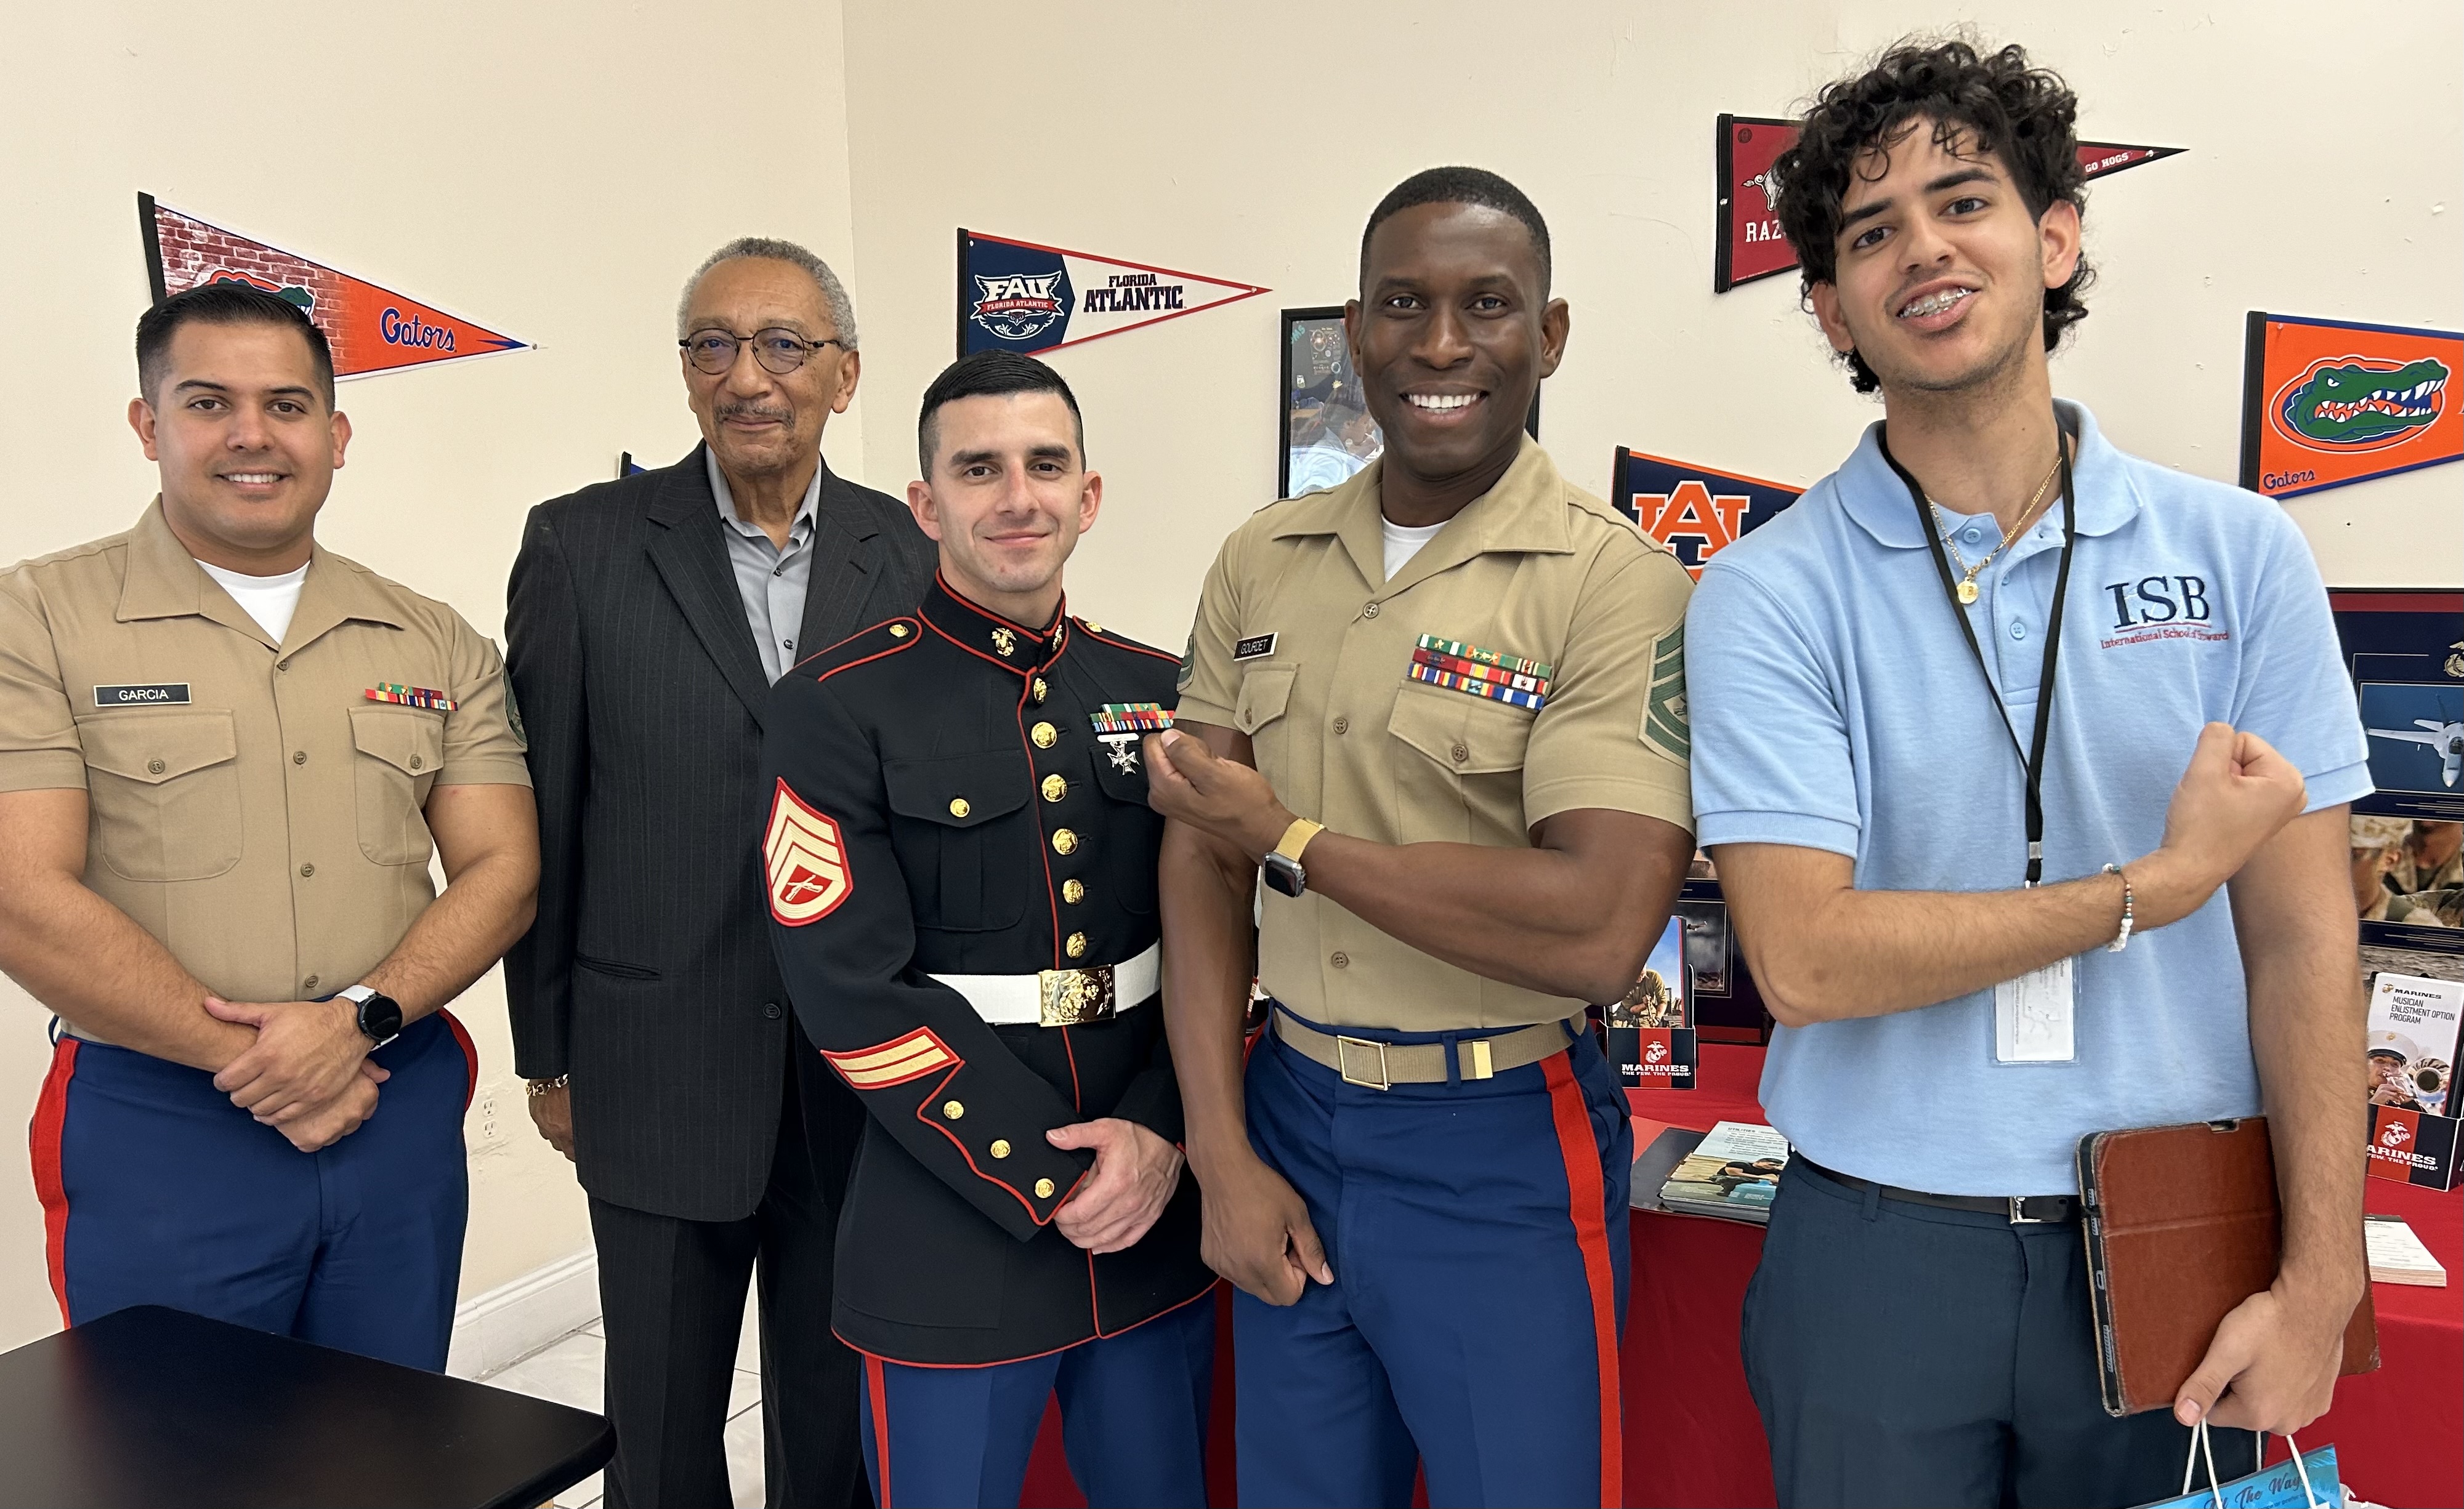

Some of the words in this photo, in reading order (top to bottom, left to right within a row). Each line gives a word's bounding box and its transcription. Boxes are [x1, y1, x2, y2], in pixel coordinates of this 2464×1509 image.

[2085, 161, 2099, 172] GO
[2101, 152, 2129, 168] HOGS
[983, 278, 1053, 302] FAU
[1109, 273, 1157, 288] FLORIDA
[987, 300, 1014, 310] FLORIDA
[1017, 300, 1048, 308] ATLANTIC
[1083, 285, 1183, 313] ATLANTIC
[381, 307, 455, 353] Gators
[2263, 469, 2315, 490] Gators
[2105, 576, 2210, 629] ISB
[2101, 628, 2162, 649] International
[119, 689, 169, 701] GARCIA
[2392, 996, 2424, 1008] MUSICIAN
[2394, 988, 2442, 999] MARINES
[2389, 1013, 2421, 1024] PROGRAM
[2391, 1004, 2431, 1017] ENLISTMENT
[2431, 1010, 2455, 1021] OPTION
[1621, 1063, 1689, 1072] MARINES
[2365, 1144, 2436, 1165] ARINES
[2234, 1486, 2263, 1509] The
